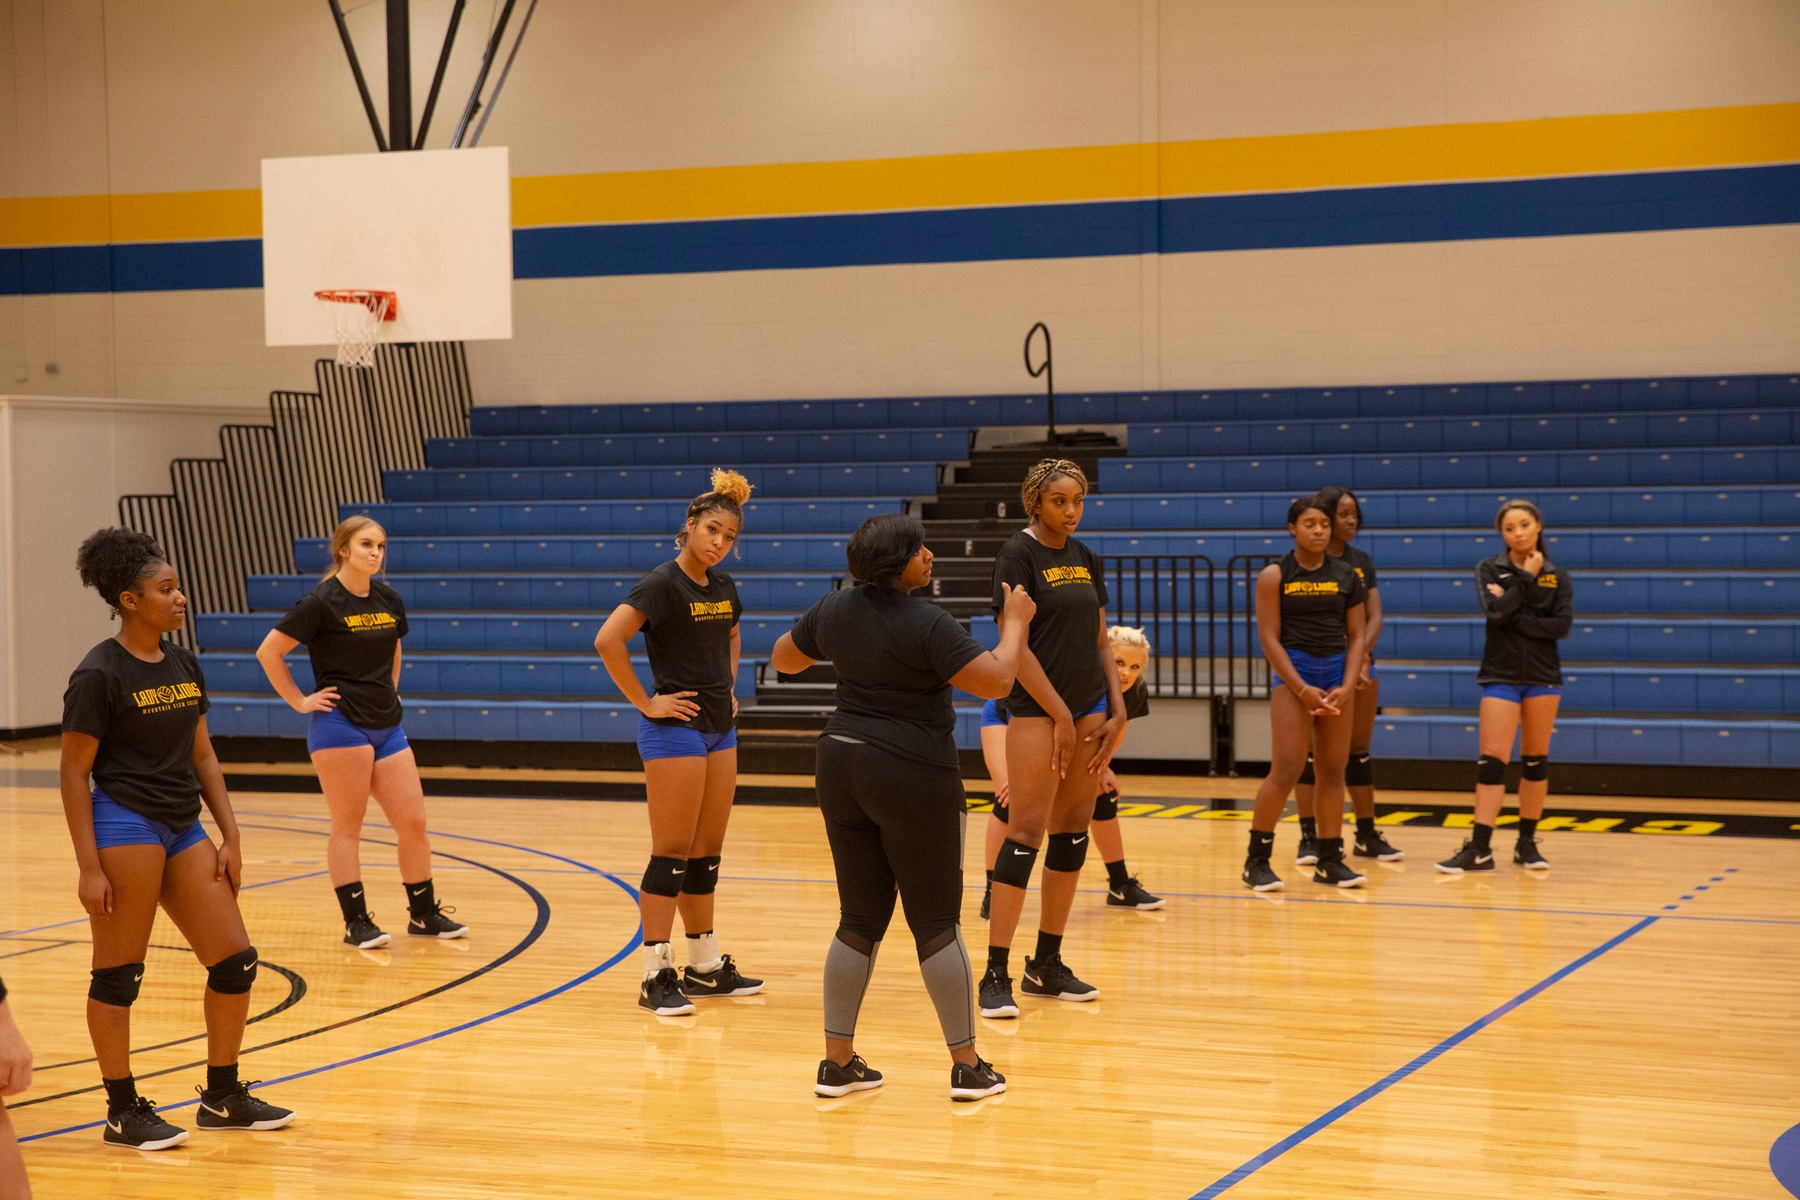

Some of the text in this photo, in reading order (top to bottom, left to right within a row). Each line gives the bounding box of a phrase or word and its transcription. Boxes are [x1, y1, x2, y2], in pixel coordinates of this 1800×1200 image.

[1042, 566, 1091, 582] LADY LIONS
[689, 600, 733, 616] LADY LIONS
[344, 612, 397, 628] LADY LIONS
[132, 682, 202, 707] LADY LIONS
